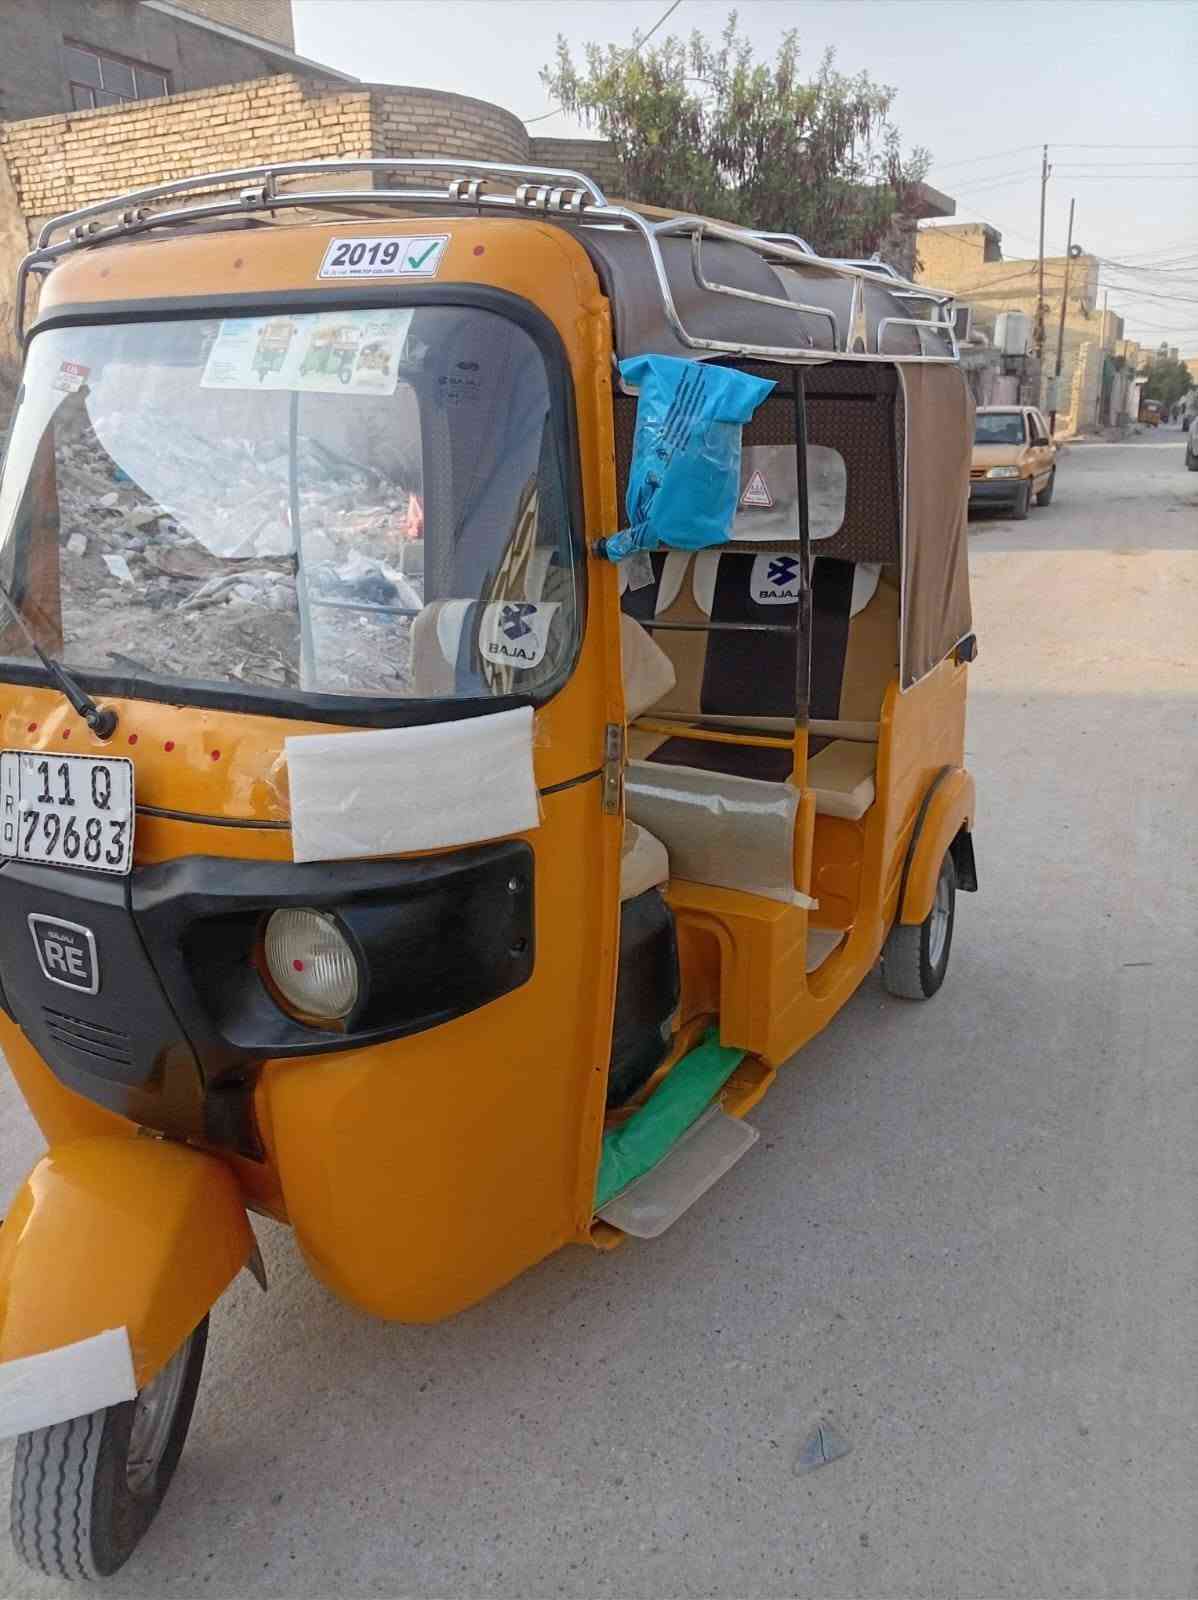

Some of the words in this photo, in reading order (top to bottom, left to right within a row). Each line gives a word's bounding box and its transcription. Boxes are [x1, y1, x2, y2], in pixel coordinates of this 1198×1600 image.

[331, 241, 400, 267] 2019
[488, 642, 537, 662] BAJAJ
[37, 761, 75, 806] 11
[90, 765, 112, 811] Q
[23, 810, 127, 865] 79683
[44, 939, 88, 978] RE
